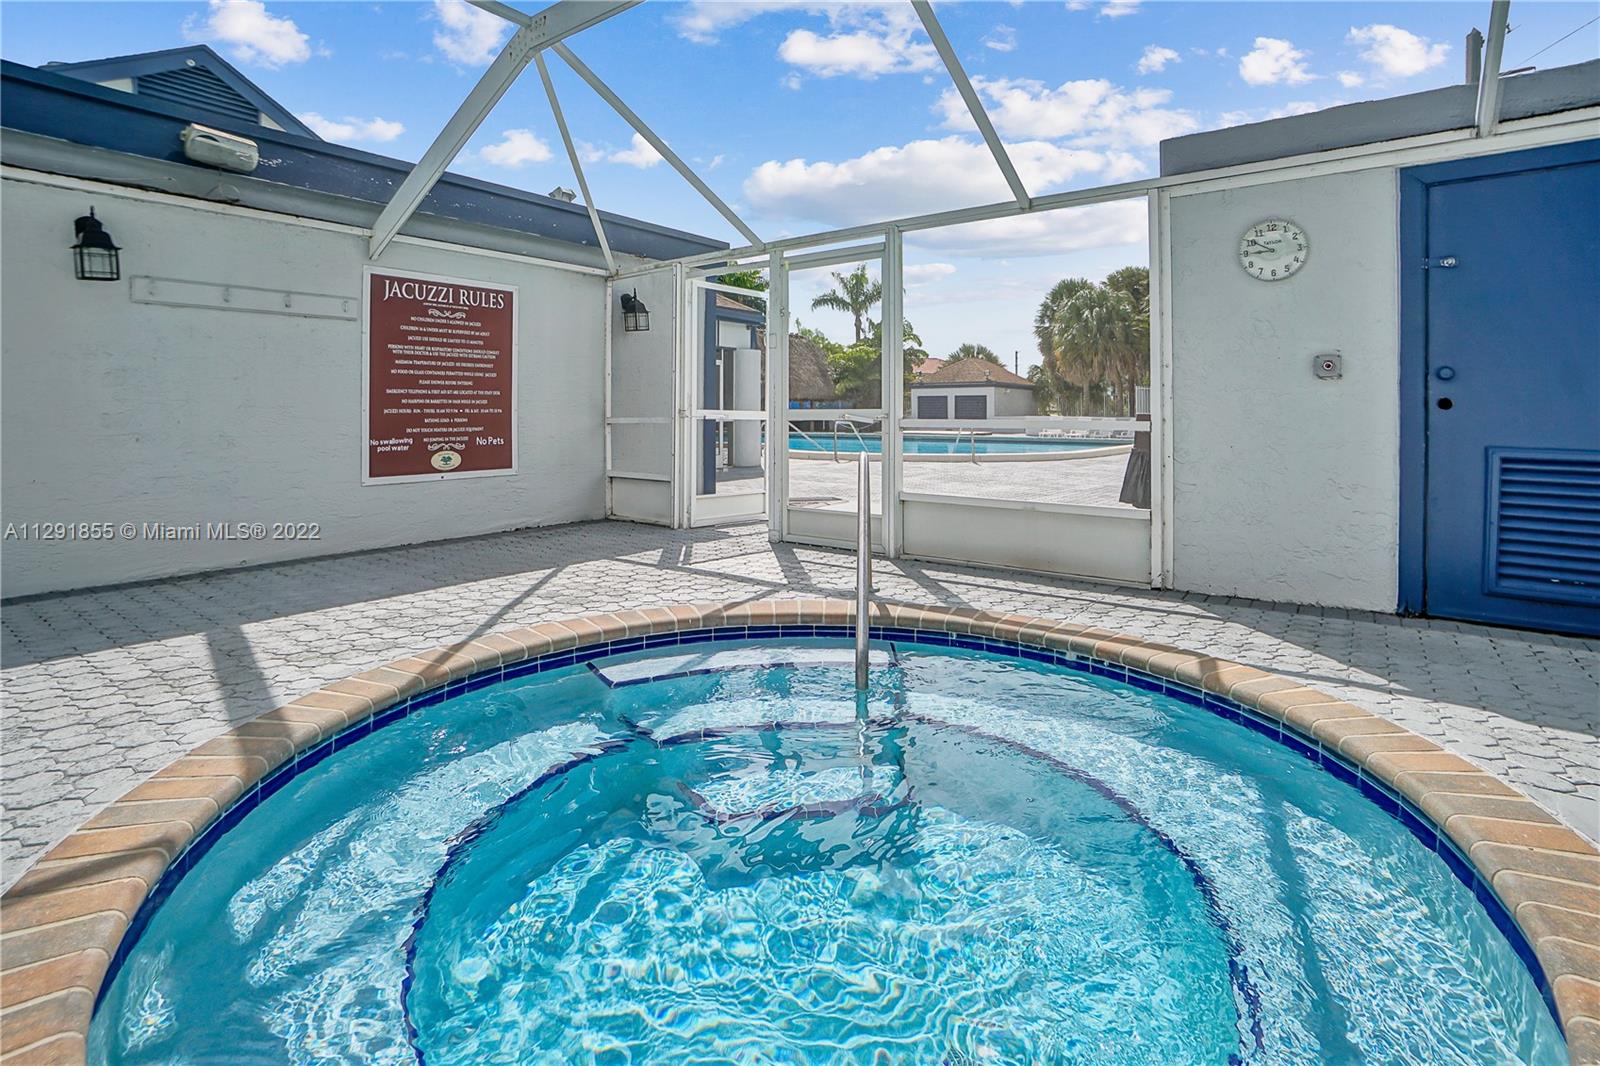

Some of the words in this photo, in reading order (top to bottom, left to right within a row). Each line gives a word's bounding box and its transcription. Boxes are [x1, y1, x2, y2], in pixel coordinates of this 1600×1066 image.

[384, 279, 453, 303] JACUZZI
[459, 288, 504, 309] RULES
[476, 436, 487, 445] No
[488, 436, 504, 445] Pets
